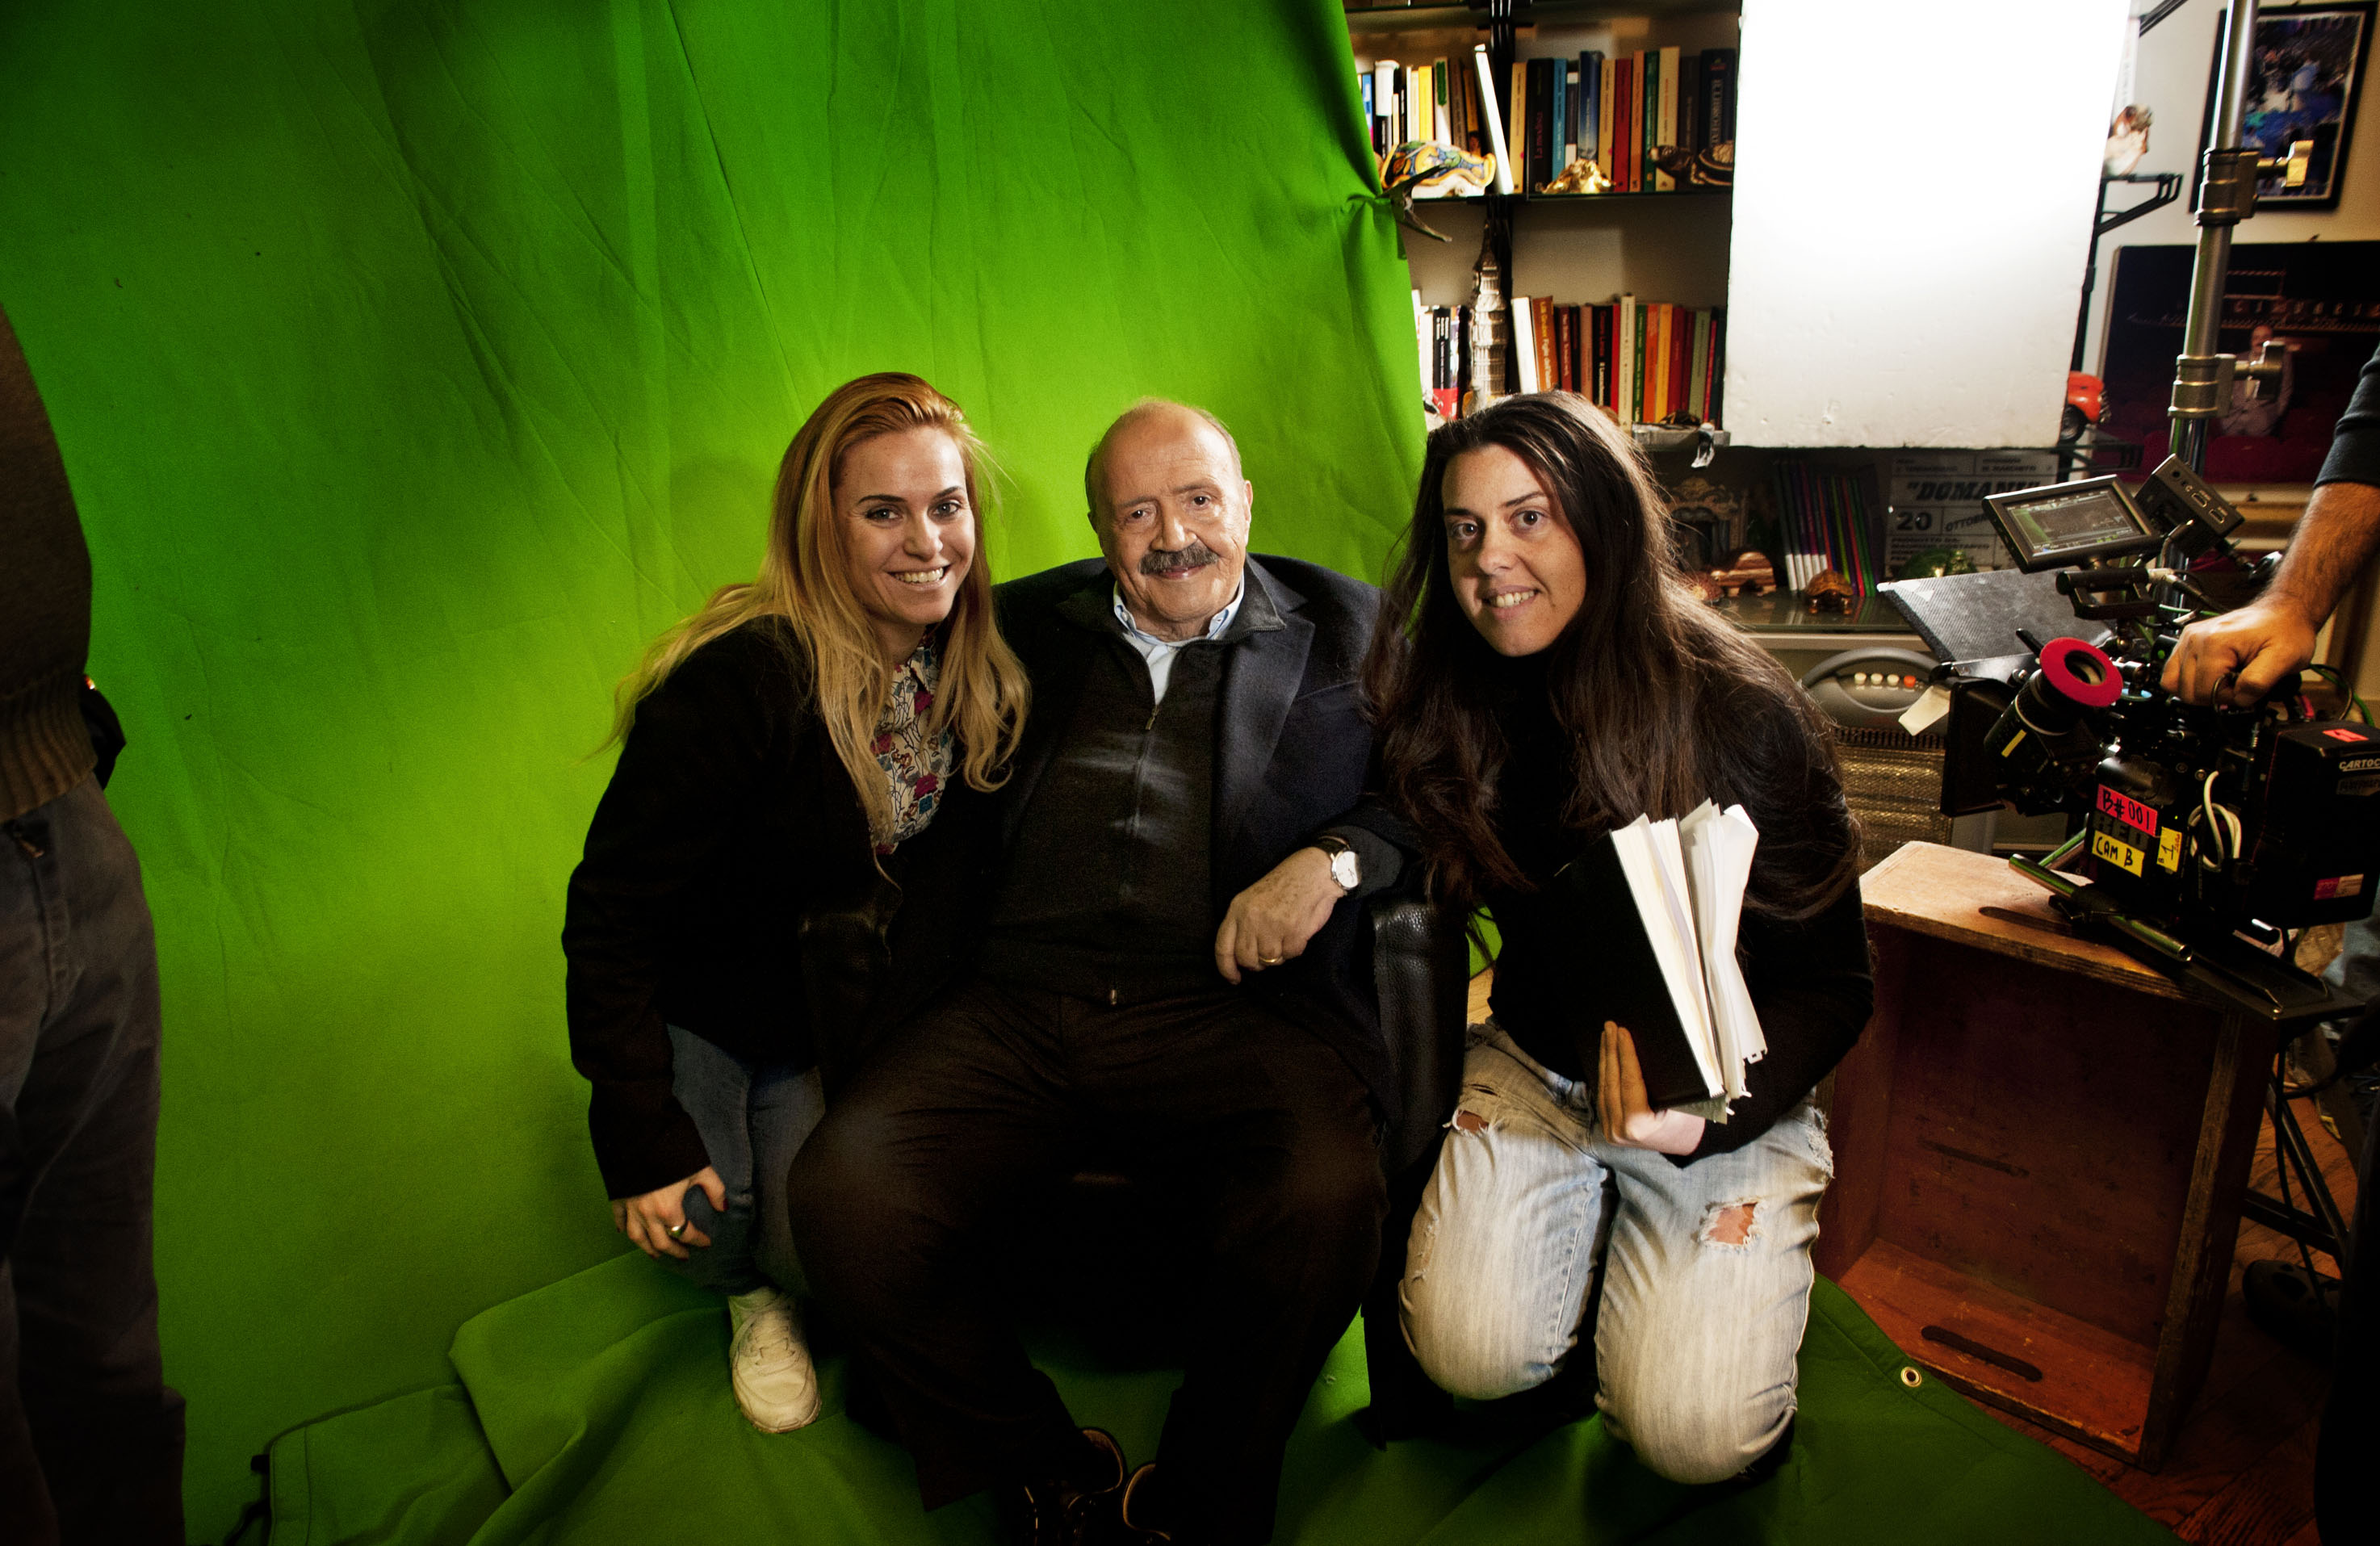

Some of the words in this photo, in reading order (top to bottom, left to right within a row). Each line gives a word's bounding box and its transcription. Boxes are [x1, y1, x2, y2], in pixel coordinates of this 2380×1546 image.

[1896, 512, 1931, 531] 20
[2097, 836, 2118, 860] CAM
[2124, 848, 2133, 867] B
